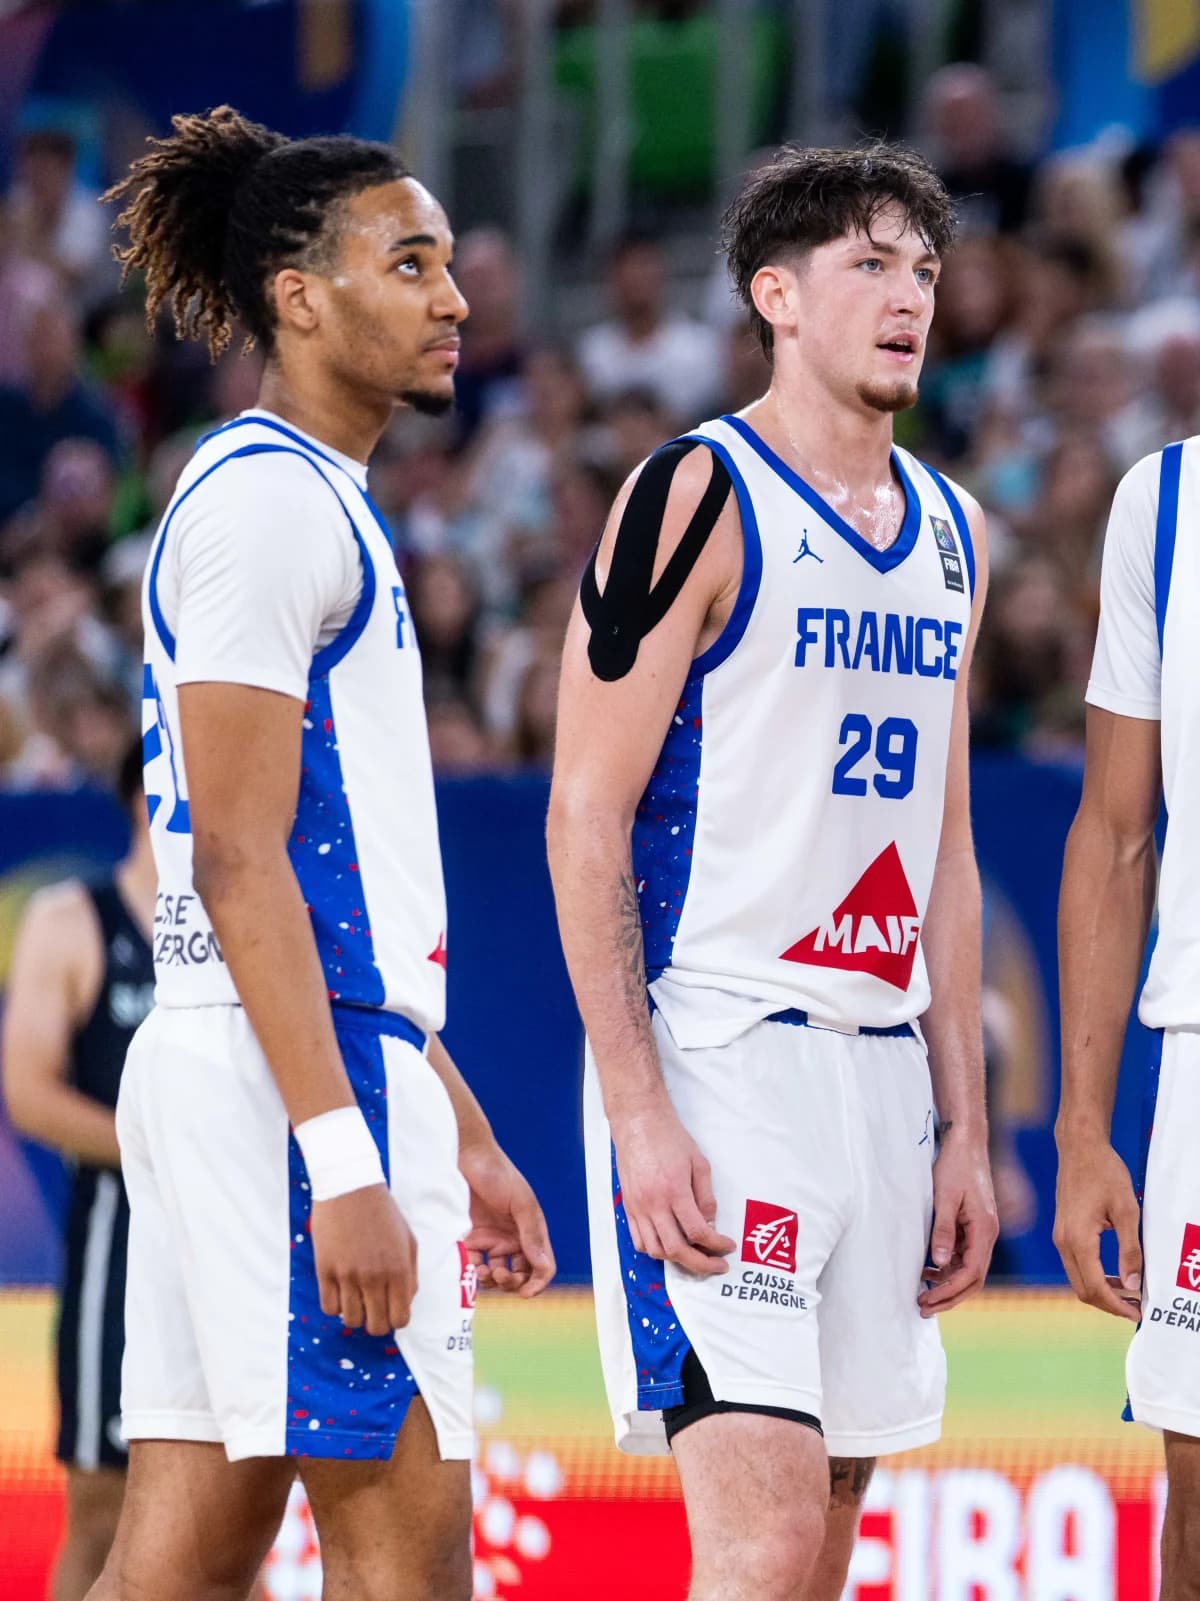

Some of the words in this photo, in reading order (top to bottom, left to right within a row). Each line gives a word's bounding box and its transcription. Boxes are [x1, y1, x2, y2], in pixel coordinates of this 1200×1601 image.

[795, 608, 962, 681] FRANCE
[832, 713, 918, 800] 29
[813, 914, 921, 955] MAIF
[721, 1284, 807, 1310] D'EPARGNE
[742, 1271, 794, 1292] CAISSE
